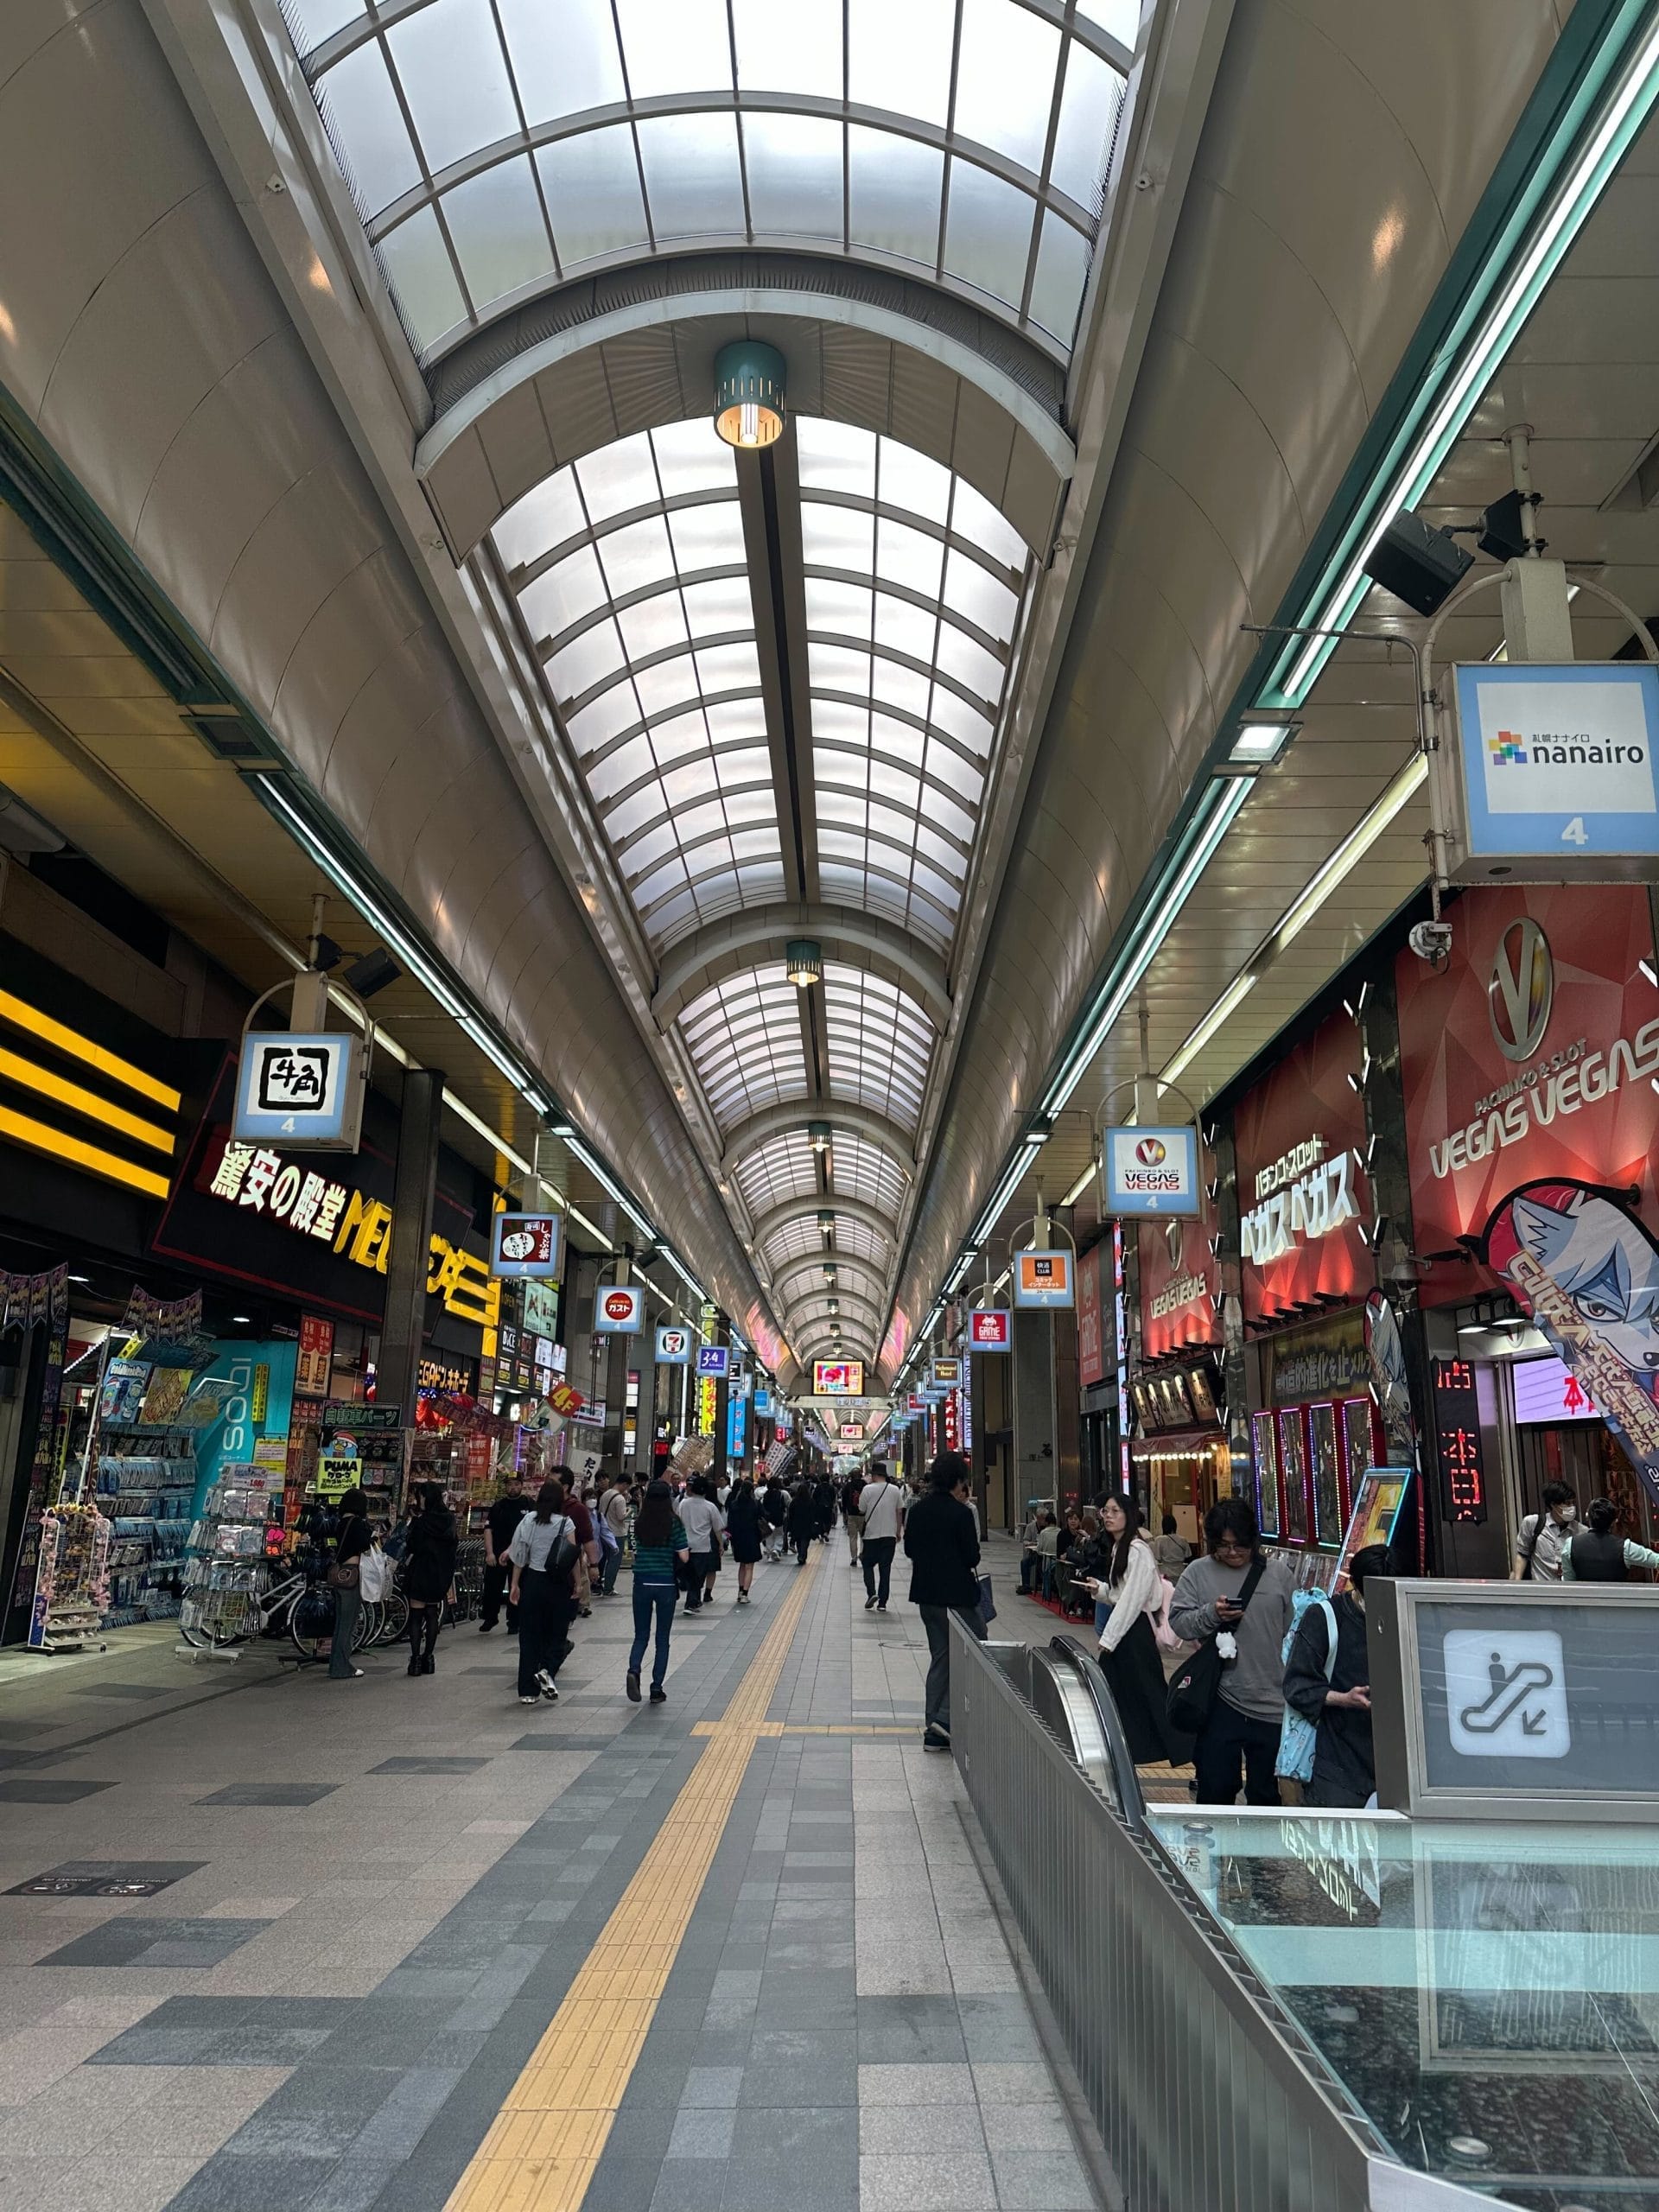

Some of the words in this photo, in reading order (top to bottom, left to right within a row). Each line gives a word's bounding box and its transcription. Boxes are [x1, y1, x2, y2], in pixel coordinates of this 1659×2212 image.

[1532, 734, 1590, 743] 札幌ナナイロ
[1533, 739, 1643, 764] nanairo
[1561, 817, 1589, 845] 4
[270, 1058, 319, 1096] 牛角
[1474, 1071, 1538, 1116] PACHINKO
[1540, 1062, 1550, 1079] &
[1551, 1038, 1587, 1072] SLOT
[1429, 1095, 1529, 1179] VEGAS
[1529, 1017, 1659, 1125] VEGAS
[281, 1117, 296, 1133] 4
[1125, 1173, 1179, 1182] VEGAS
[1146, 1195, 1158, 1209] 4
[519, 1263, 528, 1273] 4
[1040, 1295, 1048, 1304] 4
[608, 1304, 631, 1313] ガスト
[978, 1326, 1000, 1336] GAME
[552, 1387, 575, 1412] 4F
[324, 1408, 397, 1425] 自転車パーツ
[324, 1460, 358, 1471] PUMA
